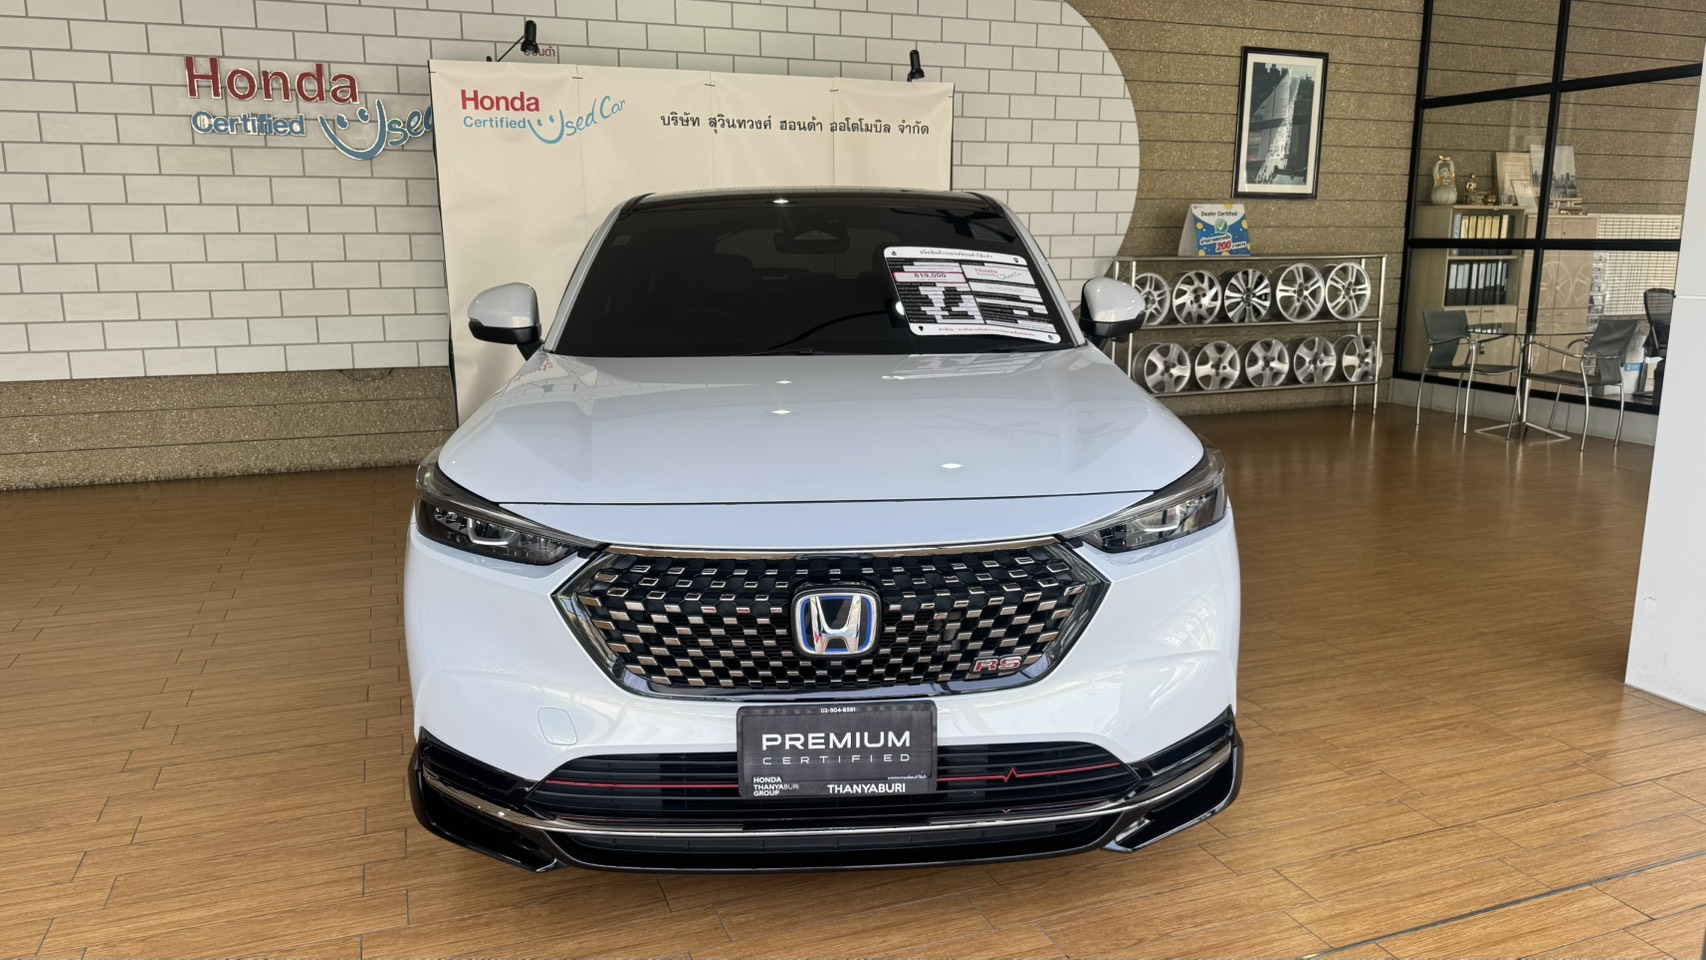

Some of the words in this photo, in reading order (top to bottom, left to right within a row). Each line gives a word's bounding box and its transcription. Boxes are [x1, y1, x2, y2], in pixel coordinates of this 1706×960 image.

[184, 55, 360, 104] Honda
[461, 89, 540, 112] Honda
[191, 110, 306, 137] Certified
[463, 116, 527, 129] Certified
[527, 99, 598, 144] Used
[600, 95, 626, 119] Car
[660, 111, 700, 127] บริษัท
[708, 113, 772, 134] สุวินทวงศ์
[779, 115, 823, 132] ฮอนด้า
[830, 117, 891, 134] ออโตโมบิล
[898, 120, 929, 135] จำกัด
[1217, 240, 1232, 251] 200
[973, 657, 1022, 672] RS
[761, 730, 911, 750] PREMIUM
[762, 753, 910, 765] CERTIFIED
[827, 782, 906, 794] THANYABURI
